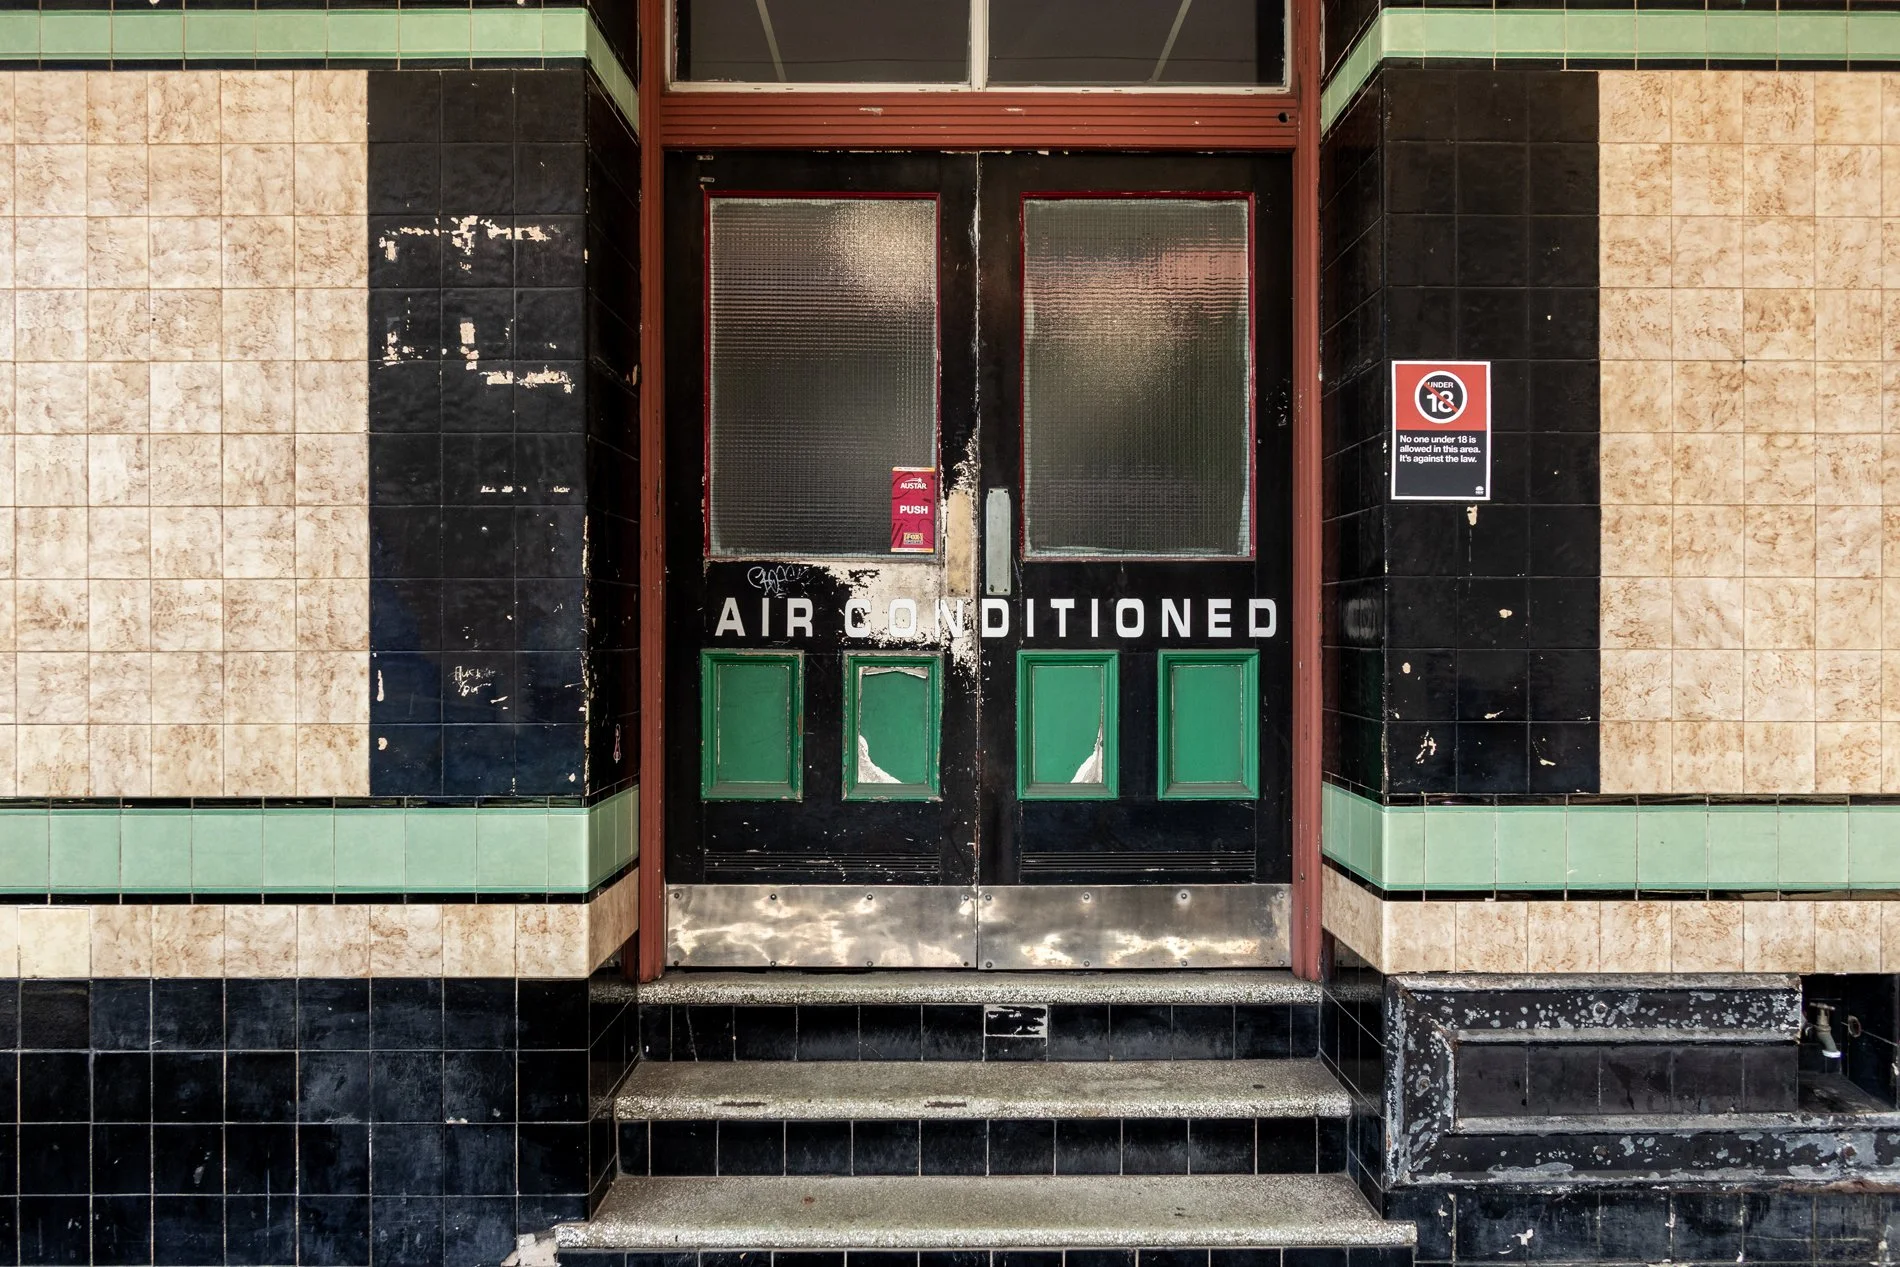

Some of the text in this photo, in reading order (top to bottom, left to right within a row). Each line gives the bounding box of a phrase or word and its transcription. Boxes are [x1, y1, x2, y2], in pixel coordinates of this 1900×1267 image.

[1426, 390, 1454, 412] 18
[1400, 435, 1412, 443] No
[1431, 435, 1456, 443] under
[1457, 435, 1468, 443] 18
[1469, 435, 1477, 443] is
[1400, 445, 1432, 453] allowed
[1433, 445, 1441, 453] in
[1443, 445, 1458, 453] this
[1400, 455, 1477, 464] It's against the law.
[900, 506, 928, 514] PUSH
[715, 597, 1277, 638] AIR CONDITIONED
